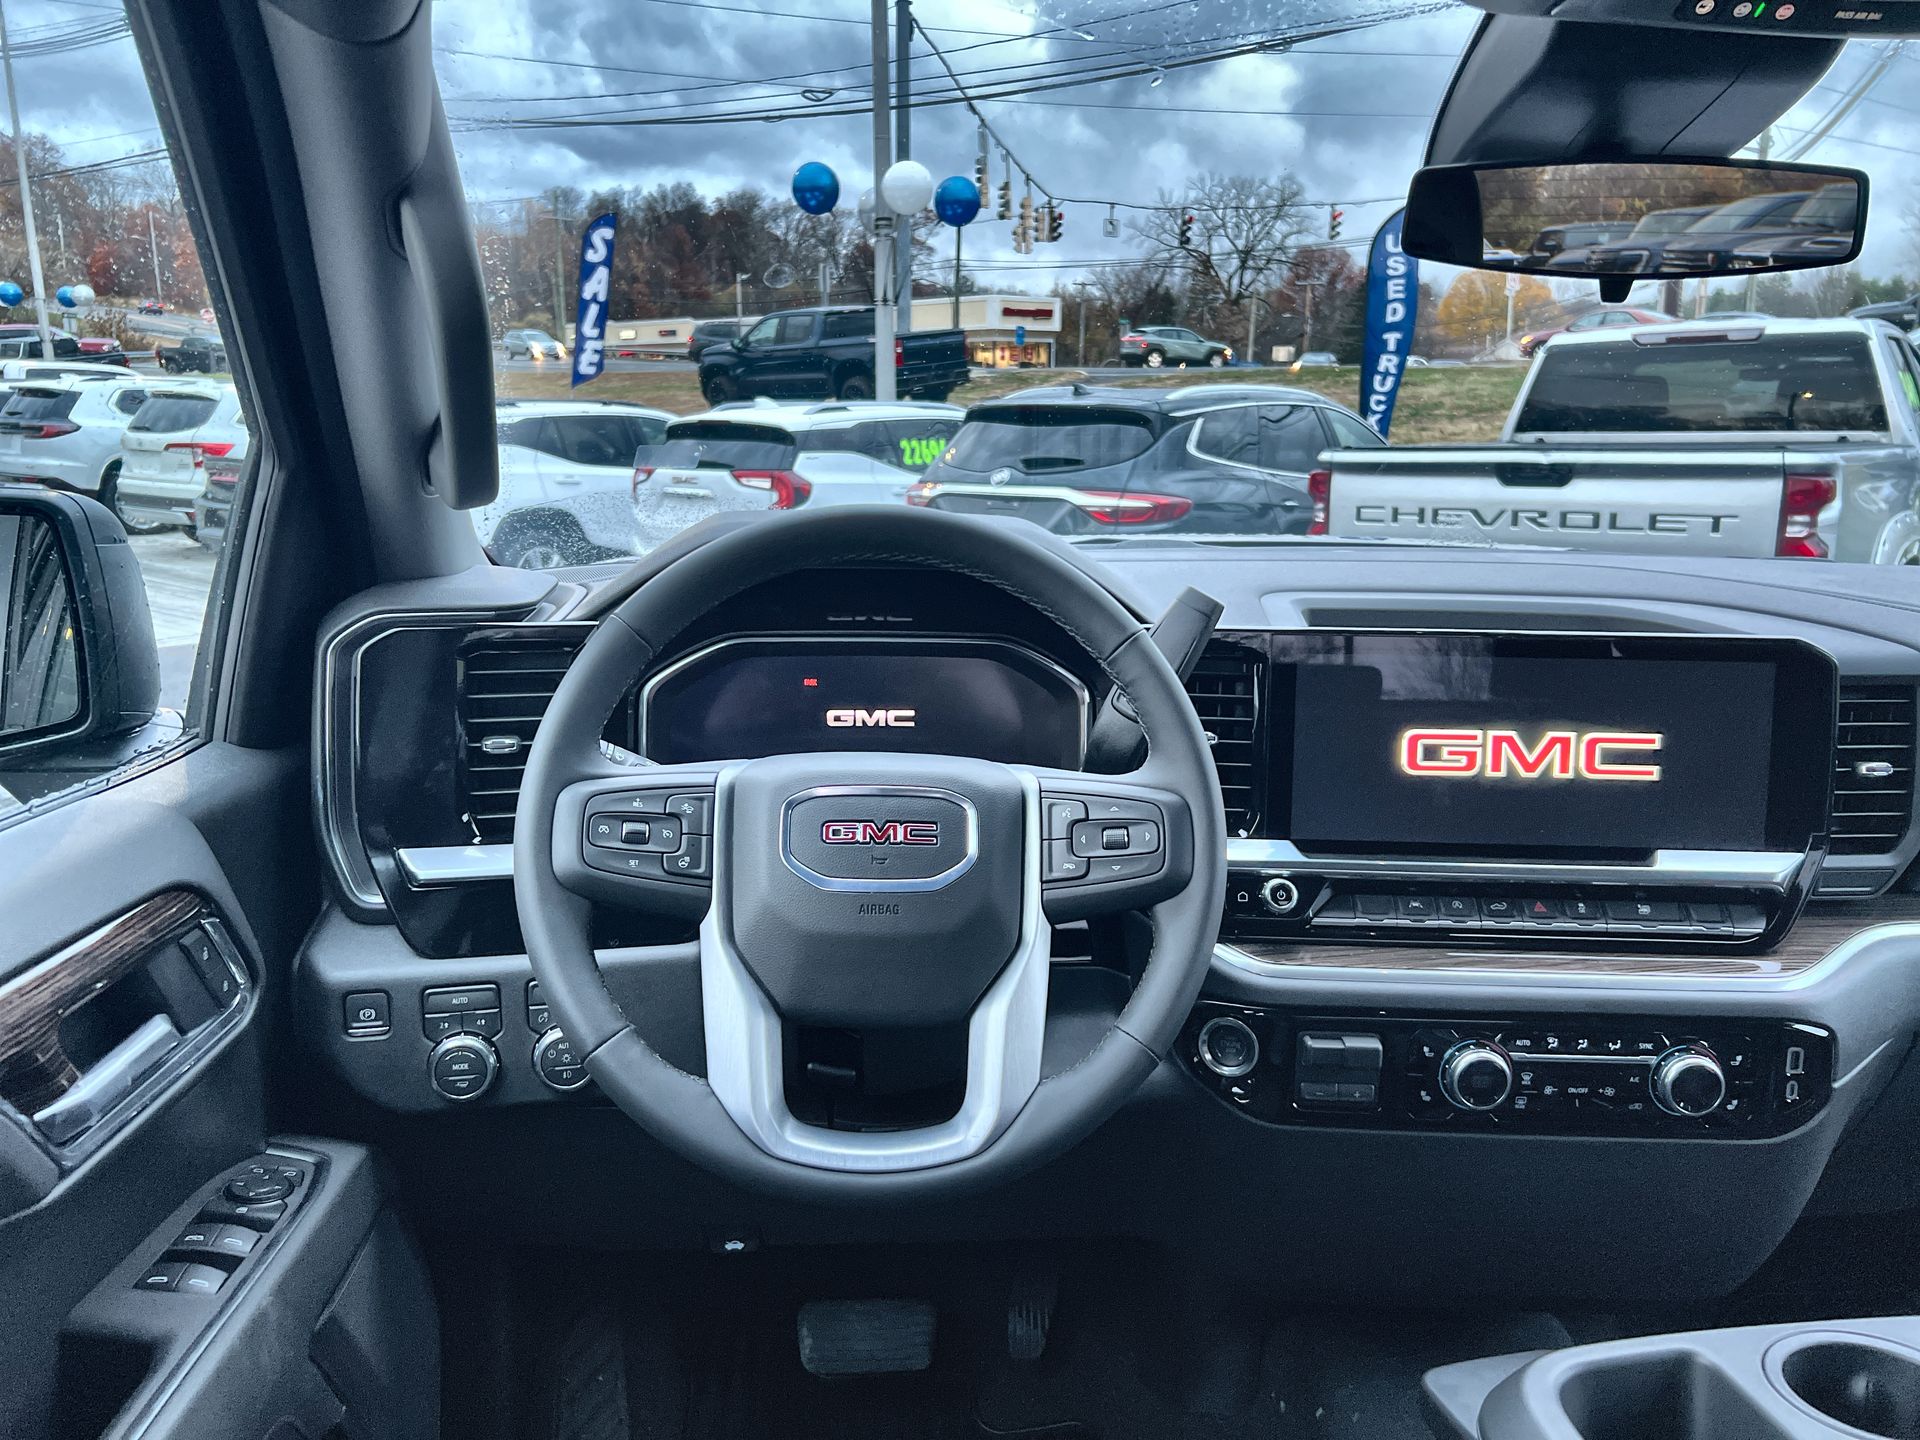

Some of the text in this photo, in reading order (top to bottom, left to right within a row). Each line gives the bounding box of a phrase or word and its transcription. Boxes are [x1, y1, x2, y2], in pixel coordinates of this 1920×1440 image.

[1385, 231, 1407, 324] USED
[577, 227, 615, 375] SALE
[1353, 504, 1740, 537] CHEVROLET
[826, 708, 916, 728] GMC
[1400, 727, 1664, 782] GMC
[822, 819, 939, 846] GMC
[858, 903, 900, 915] AIRBAG
[452, 997, 468, 1005] AUTO
[558, 1042, 570, 1050] AUT
[1567, 1086, 1589, 1095] ON/OFF
